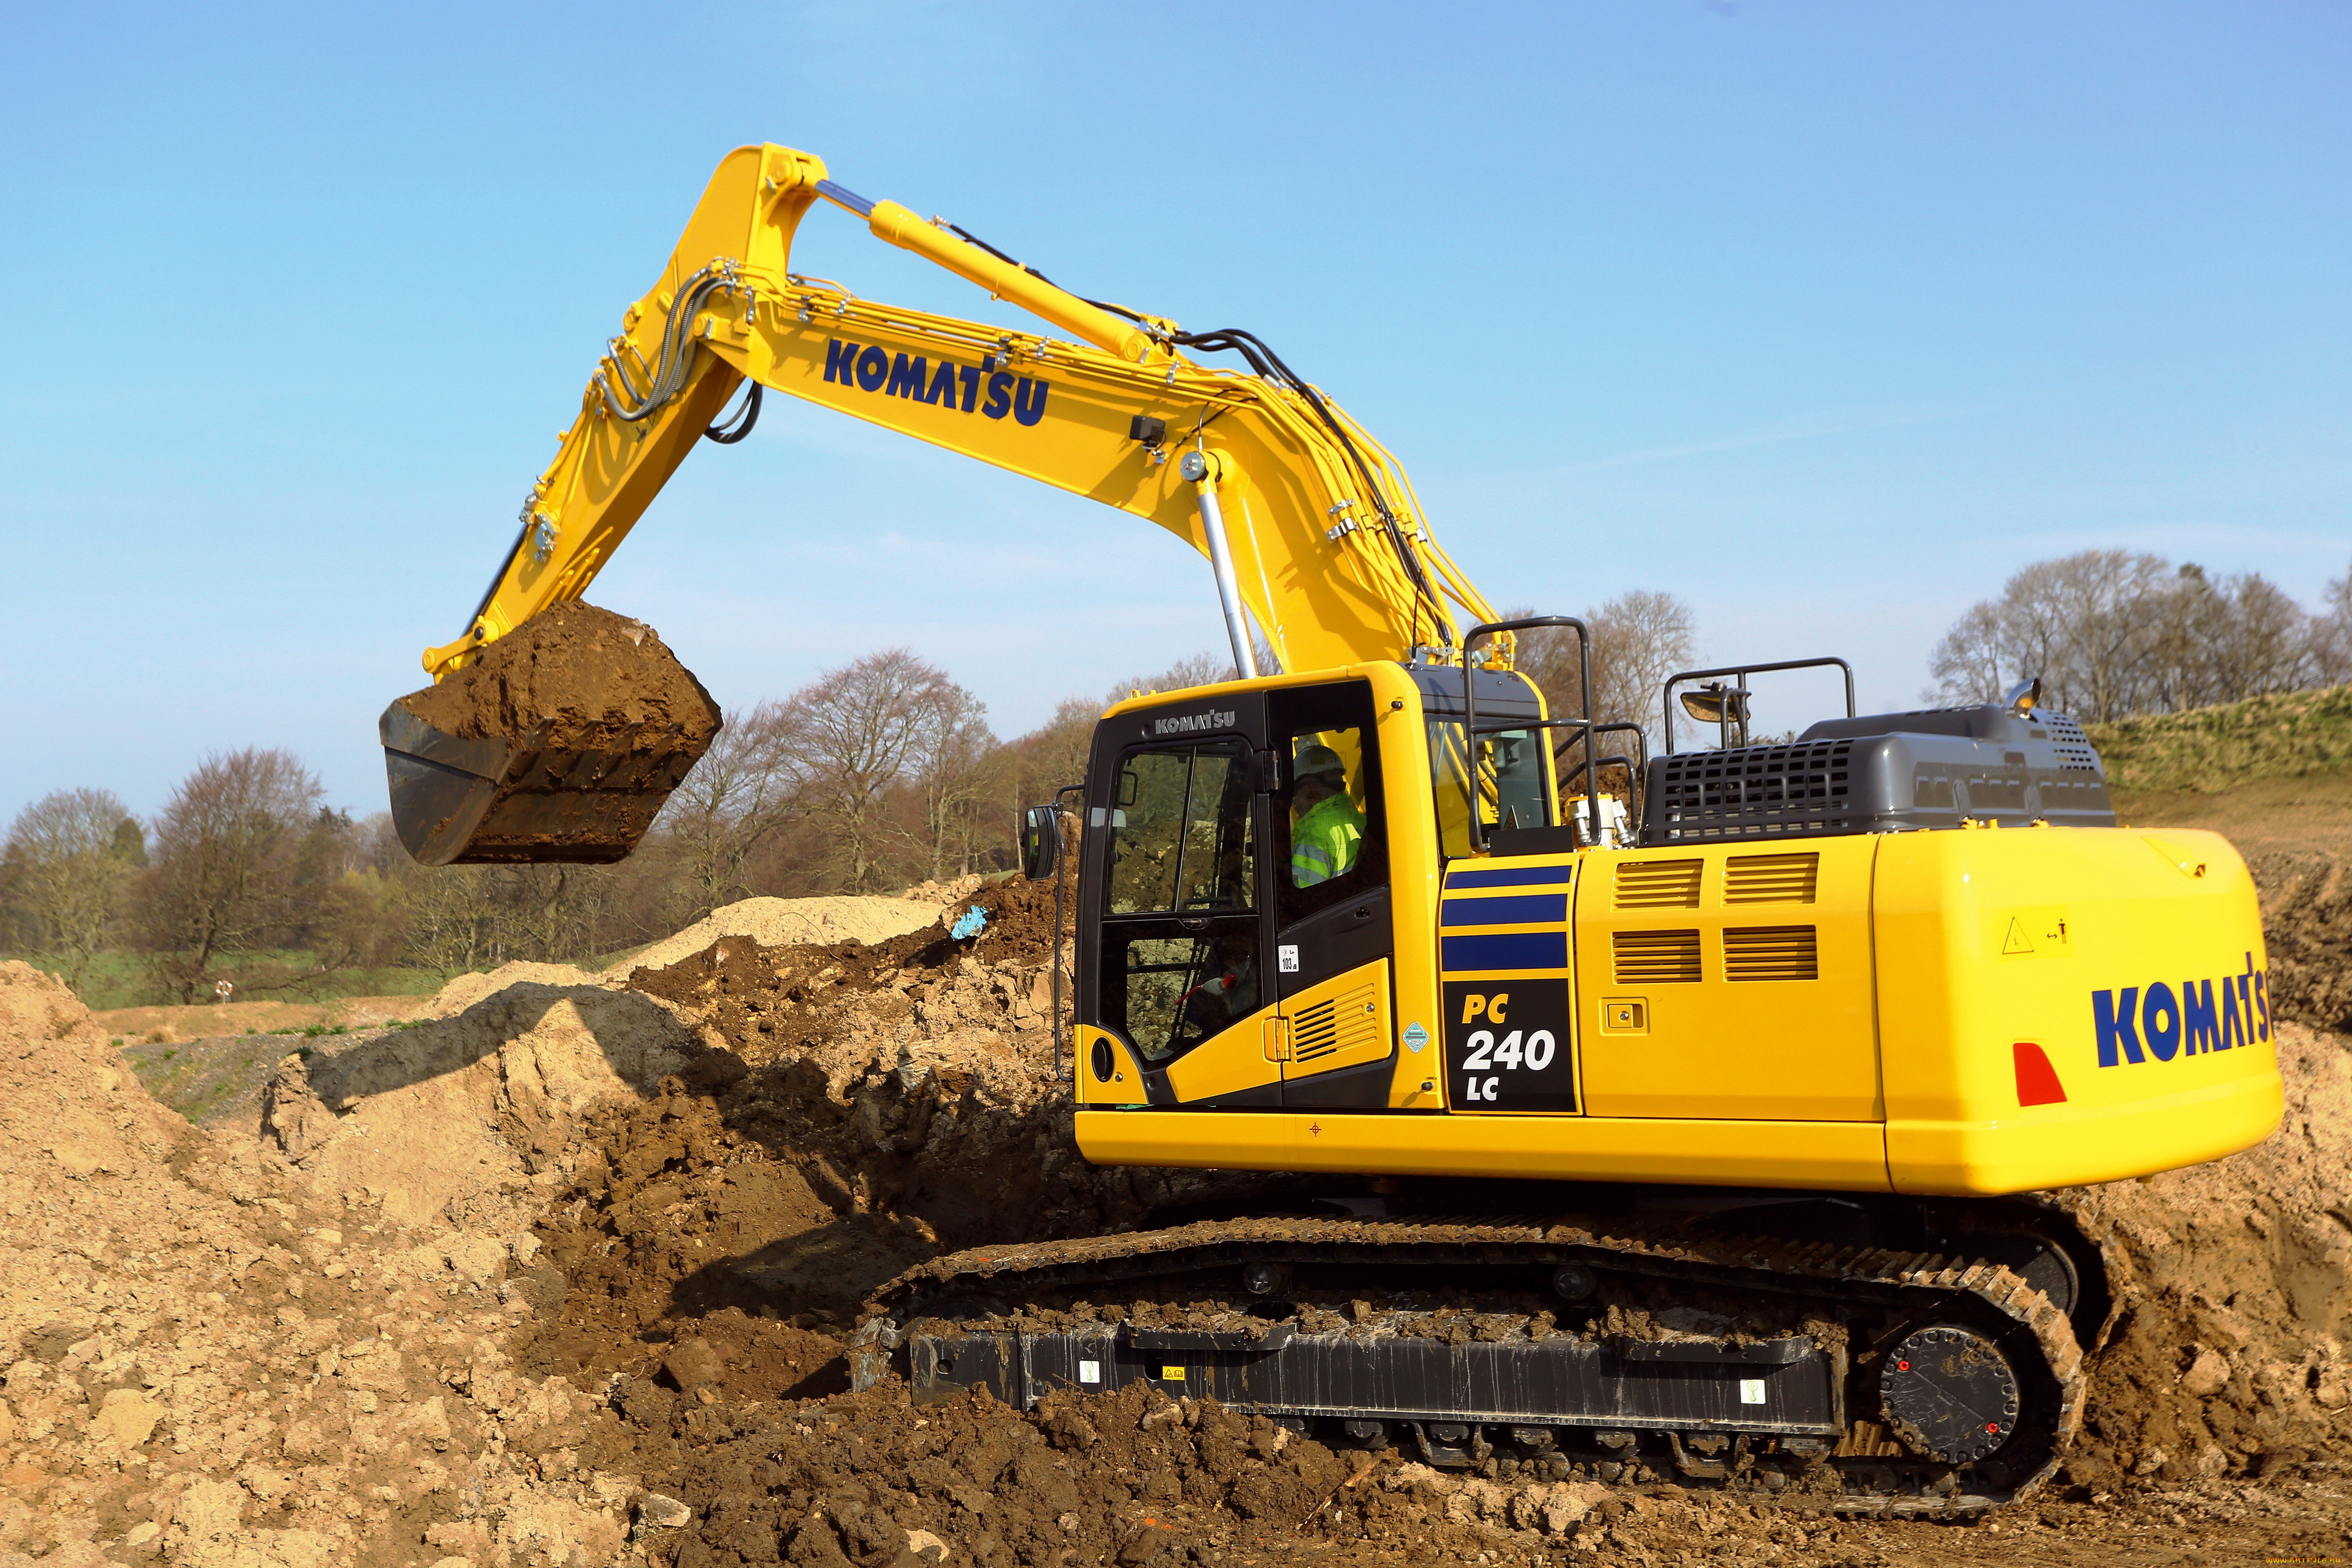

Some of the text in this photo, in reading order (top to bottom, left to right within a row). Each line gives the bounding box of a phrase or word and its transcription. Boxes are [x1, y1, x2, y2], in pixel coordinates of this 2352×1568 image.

[823, 338, 1050, 426] KOMATSU
[1155, 708, 1235, 734] KOMATSU
[1282, 958, 1292, 970] 103
[1461, 993, 1509, 1024] PC
[2091, 951, 2275, 1068] KOMATS
[1462, 1029, 1556, 1071] 240
[1467, 1077, 1499, 1101] LC
